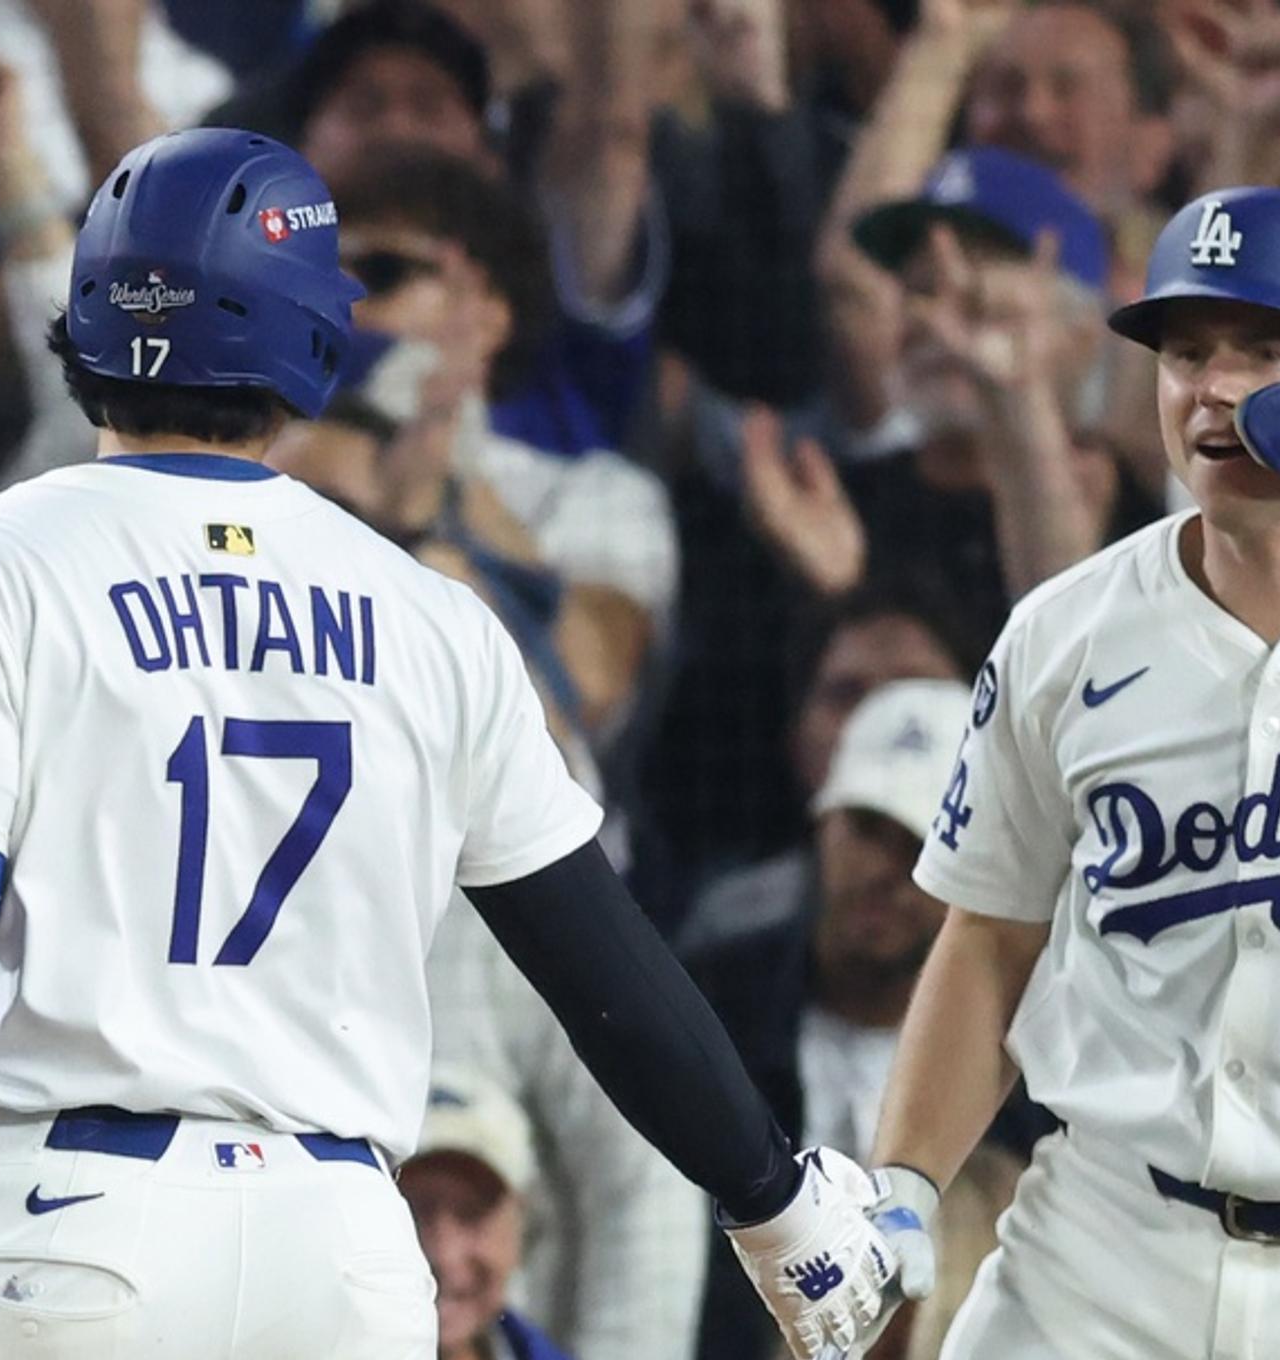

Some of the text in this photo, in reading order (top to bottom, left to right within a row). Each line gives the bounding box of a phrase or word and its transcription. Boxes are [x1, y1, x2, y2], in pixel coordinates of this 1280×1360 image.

[1190, 200, 1242, 265] LA
[130, 336, 170, 378] 17
[108, 574, 375, 685] OHTANI
[166, 716, 352, 966] 17
